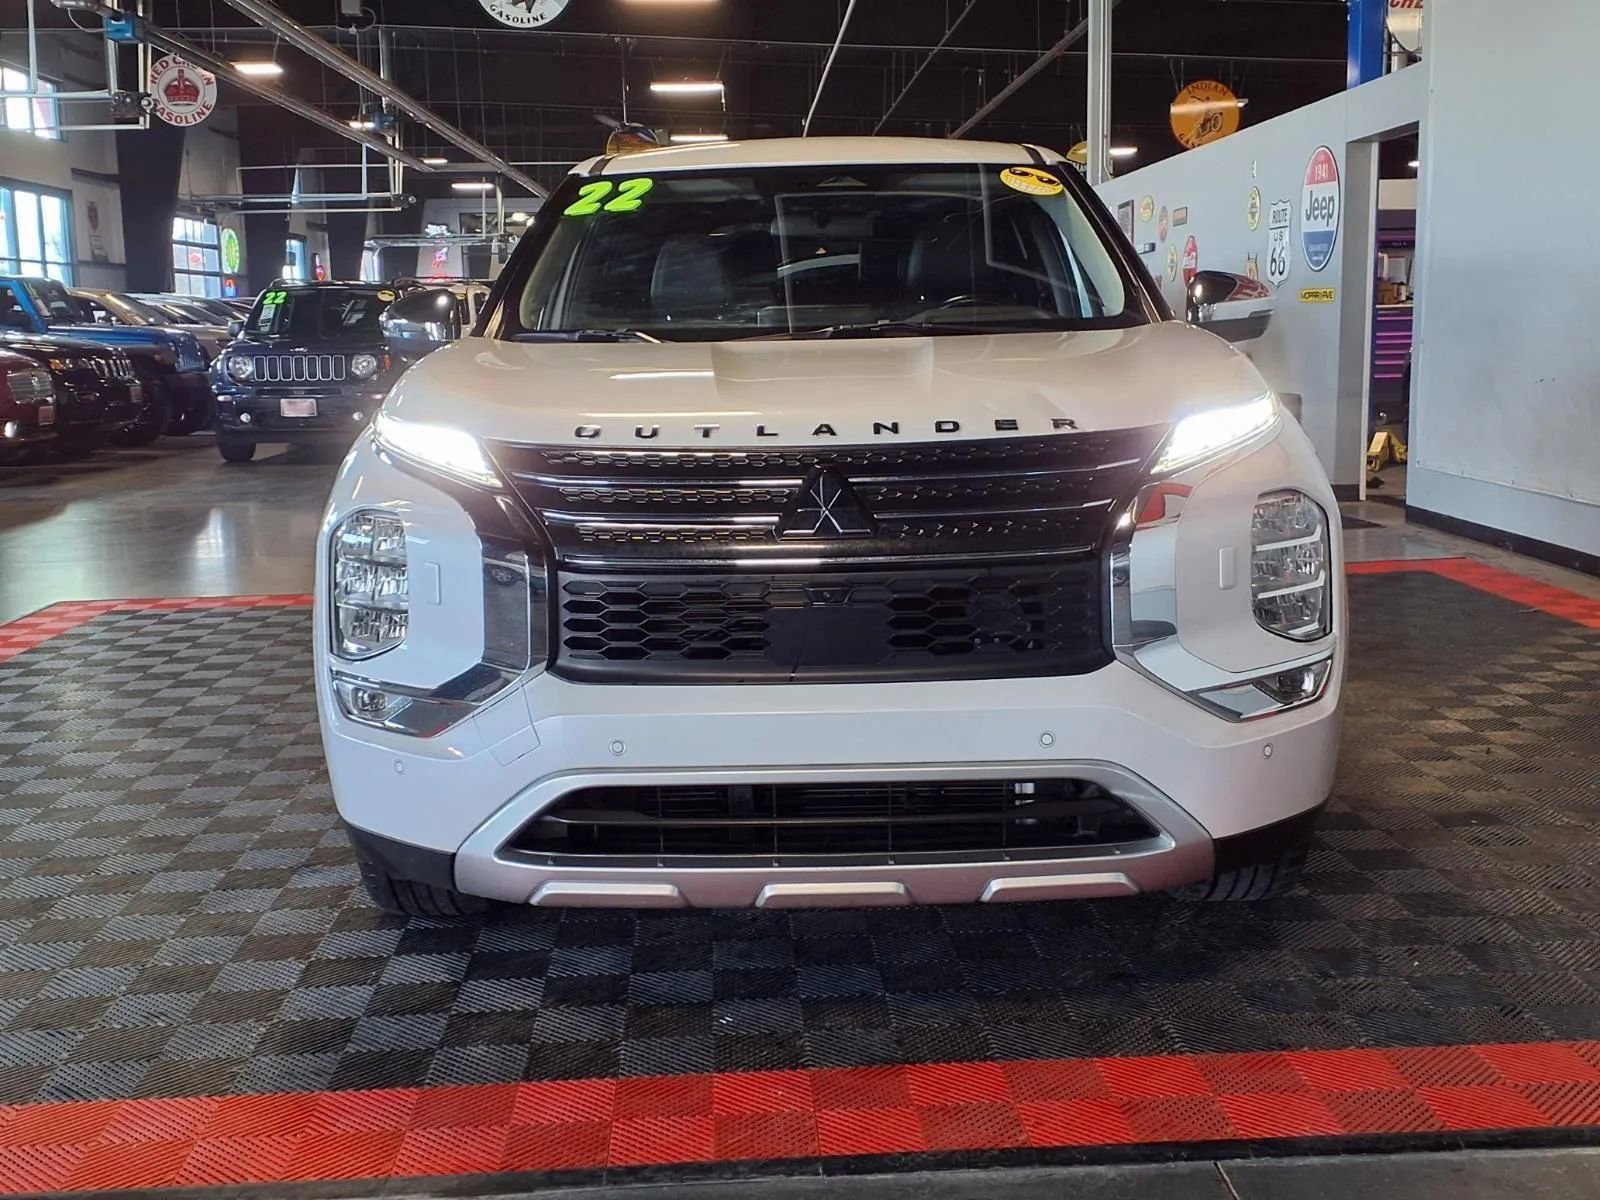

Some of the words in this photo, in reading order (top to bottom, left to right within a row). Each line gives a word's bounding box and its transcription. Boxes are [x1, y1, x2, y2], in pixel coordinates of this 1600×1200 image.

[489, 4, 547, 24] GASOLINE
[1186, 81, 1228, 97] INDIAN
[1315, 162, 1329, 180] 1941
[563, 177, 653, 216] 22
[1271, 207, 1288, 224] ROUTE
[1305, 189, 1335, 227] Jeep
[1273, 231, 1284, 242] US
[1270, 246, 1286, 276] 66
[263, 291, 287, 304] 22
[574, 418, 1079, 439] OUTLANDER
